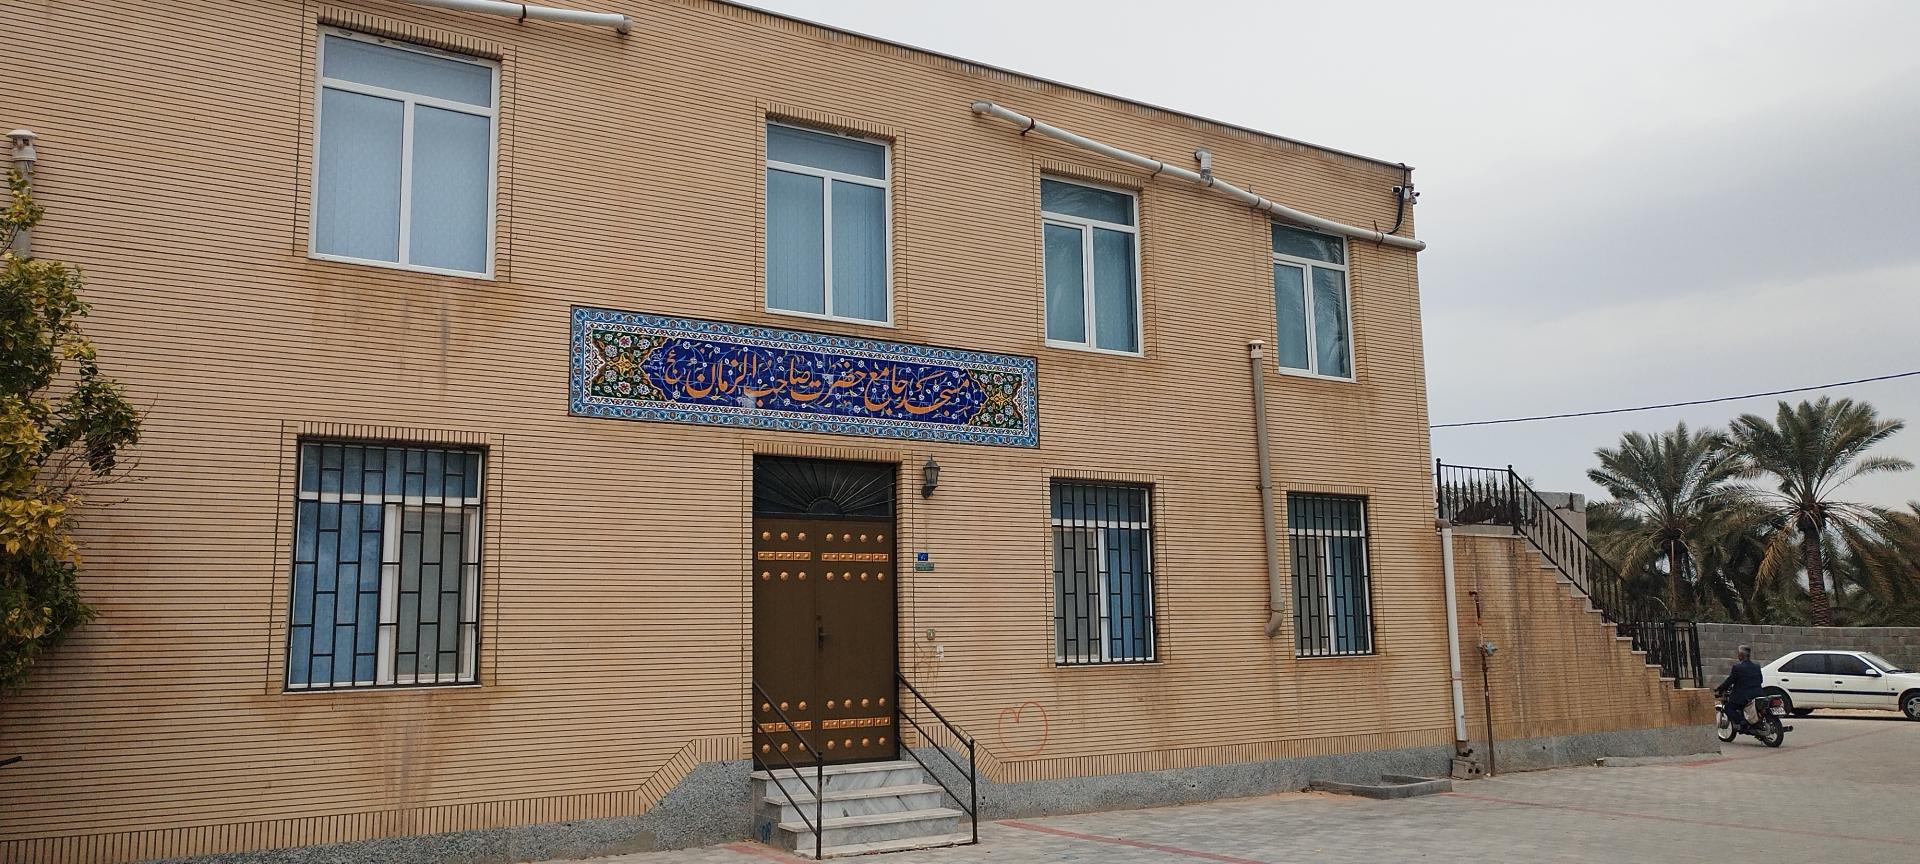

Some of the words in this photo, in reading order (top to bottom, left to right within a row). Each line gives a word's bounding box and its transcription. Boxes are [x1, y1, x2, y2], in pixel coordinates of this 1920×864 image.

[686, 352, 757, 398] الزمان
[744, 357, 811, 407] صاحب
[790, 361, 867, 405] حضرت
[864, 363, 909, 416] جامع
[895, 370, 970, 416] مسجد
